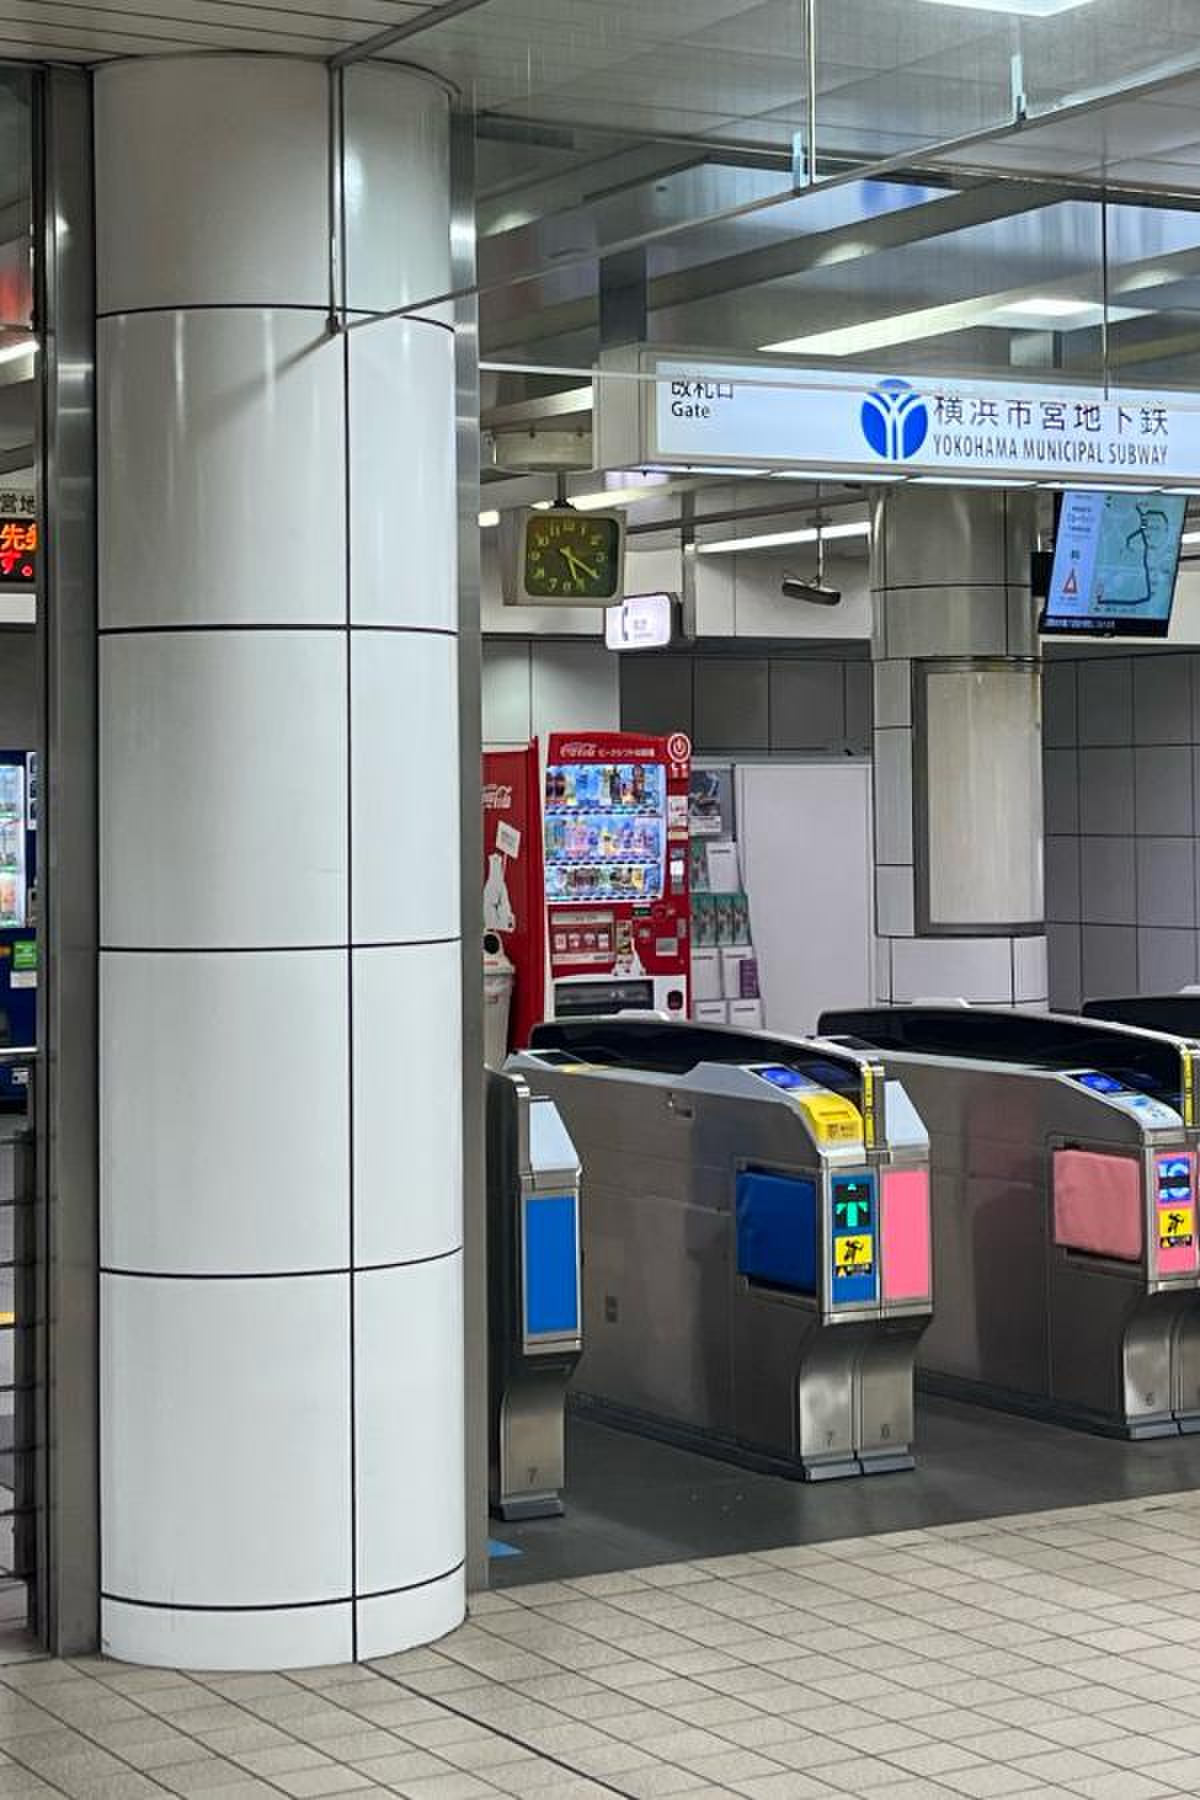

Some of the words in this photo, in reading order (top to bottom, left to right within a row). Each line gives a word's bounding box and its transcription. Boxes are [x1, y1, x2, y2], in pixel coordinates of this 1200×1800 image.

[671, 401, 710, 418] Gate
[933, 435, 1017, 458] YOKOHAMA
[1023, 438, 1103, 463] MUNICIPAL
[1108, 443, 1168, 464] SUBWAY
